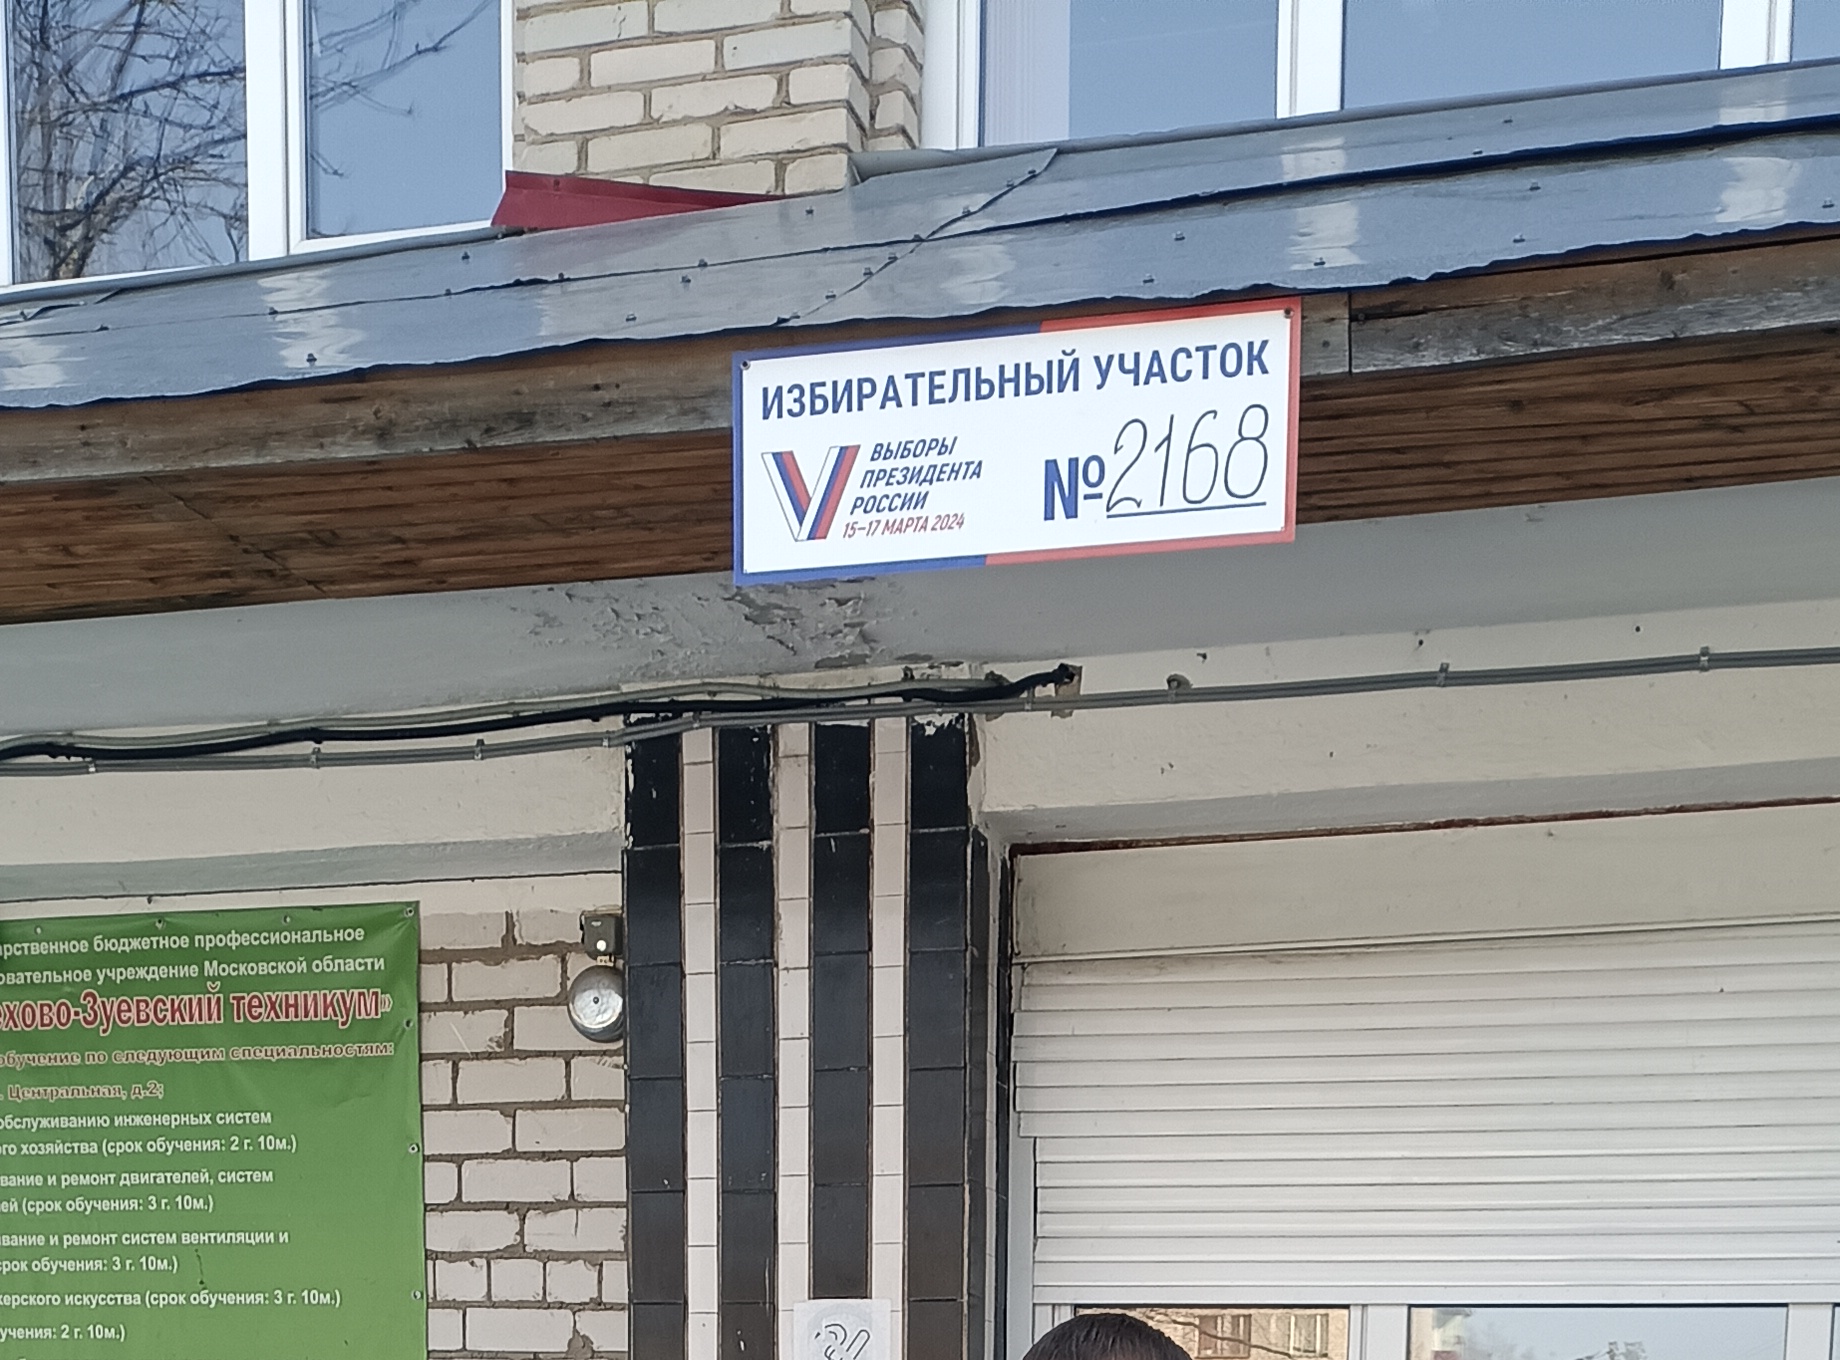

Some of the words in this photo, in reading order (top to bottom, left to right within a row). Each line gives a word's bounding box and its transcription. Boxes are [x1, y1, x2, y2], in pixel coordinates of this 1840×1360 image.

[761, 350, 1080, 420] ИЗБИРАТЕЛЬНЫЙ
[1096, 339, 1270, 391] УЧАСТОК
[870, 435, 957, 463] ВЫБОРЫ
[859, 460, 984, 490] ПРЕЗИДЕНТА
[850, 491, 929, 515] РОССИИ
[881, 516, 928, 535] МАРТА
[931, 514, 965, 532] 2024
[0, 940, 89, 959] рственное
[94, 935, 189, 953] бюджетное
[195, 928, 364, 951] профессиональное
[96, 965, 198, 985] учреждение
[204, 957, 307, 976] Московской
[312, 955, 384, 972] области
[0, 980, 223, 1036] хово-Зуевский
[230, 988, 393, 1029] техникум»
[85, 1051, 108, 1064] по
[112, 1048, 225, 1066] следующим
[229, 1042, 394, 1062] специальностям:
[8, 1084, 127, 1103] Центральная,
[114, 1113, 212, 1129] инженерных
[216, 1112, 271, 1124] систем
[0, 1144, 17, 1155] го
[21, 1140, 98, 1155] хозяйства
[103, 1139, 143, 1157] (срок
[147, 1137, 225, 1155] обучения:
[230, 1136, 239, 1150] 2
[244, 1139, 253, 1150] г.
[258, 1135, 296, 1153] 10м.)
[48, 1175, 56, 1186] и
[61, 1174, 116, 1189] ремонт
[120, 1169, 213, 1186] двигателей,
[218, 1171, 273, 1183] систем
[22, 1198, 62, 1215] (срок
[66, 1197, 143, 1215] обучения:
[148, 1196, 157, 1210] 3
[161, 1199, 170, 1210] г.
[175, 1195, 213, 1213] 10м.)
[50, 1235, 58, 1245] и
[63, 1234, 118, 1249] ремонт
[122, 1233, 176, 1244] систем
[182, 1232, 274, 1245] вентиляции
[279, 1232, 288, 1243] и
[0, 1261, 28, 1275] рок
[32, 1257, 107, 1274] обучения:
[113, 1256, 121, 1270] 3
[126, 1260, 135, 1270] г.
[140, 1256, 177, 1274] 10м.)
[65, 1294, 141, 1308] искусства
[145, 1290, 186, 1308] (срок
[190, 1290, 269, 1308] обучения:
[274, 1290, 282, 1304] 3
[288, 1293, 296, 1304] г.
[302, 1290, 340, 1308] 10м.)
[61, 1325, 69, 1338] 2
[74, 1328, 82, 1339] г.
[87, 1324, 125, 1342] 10м.)
